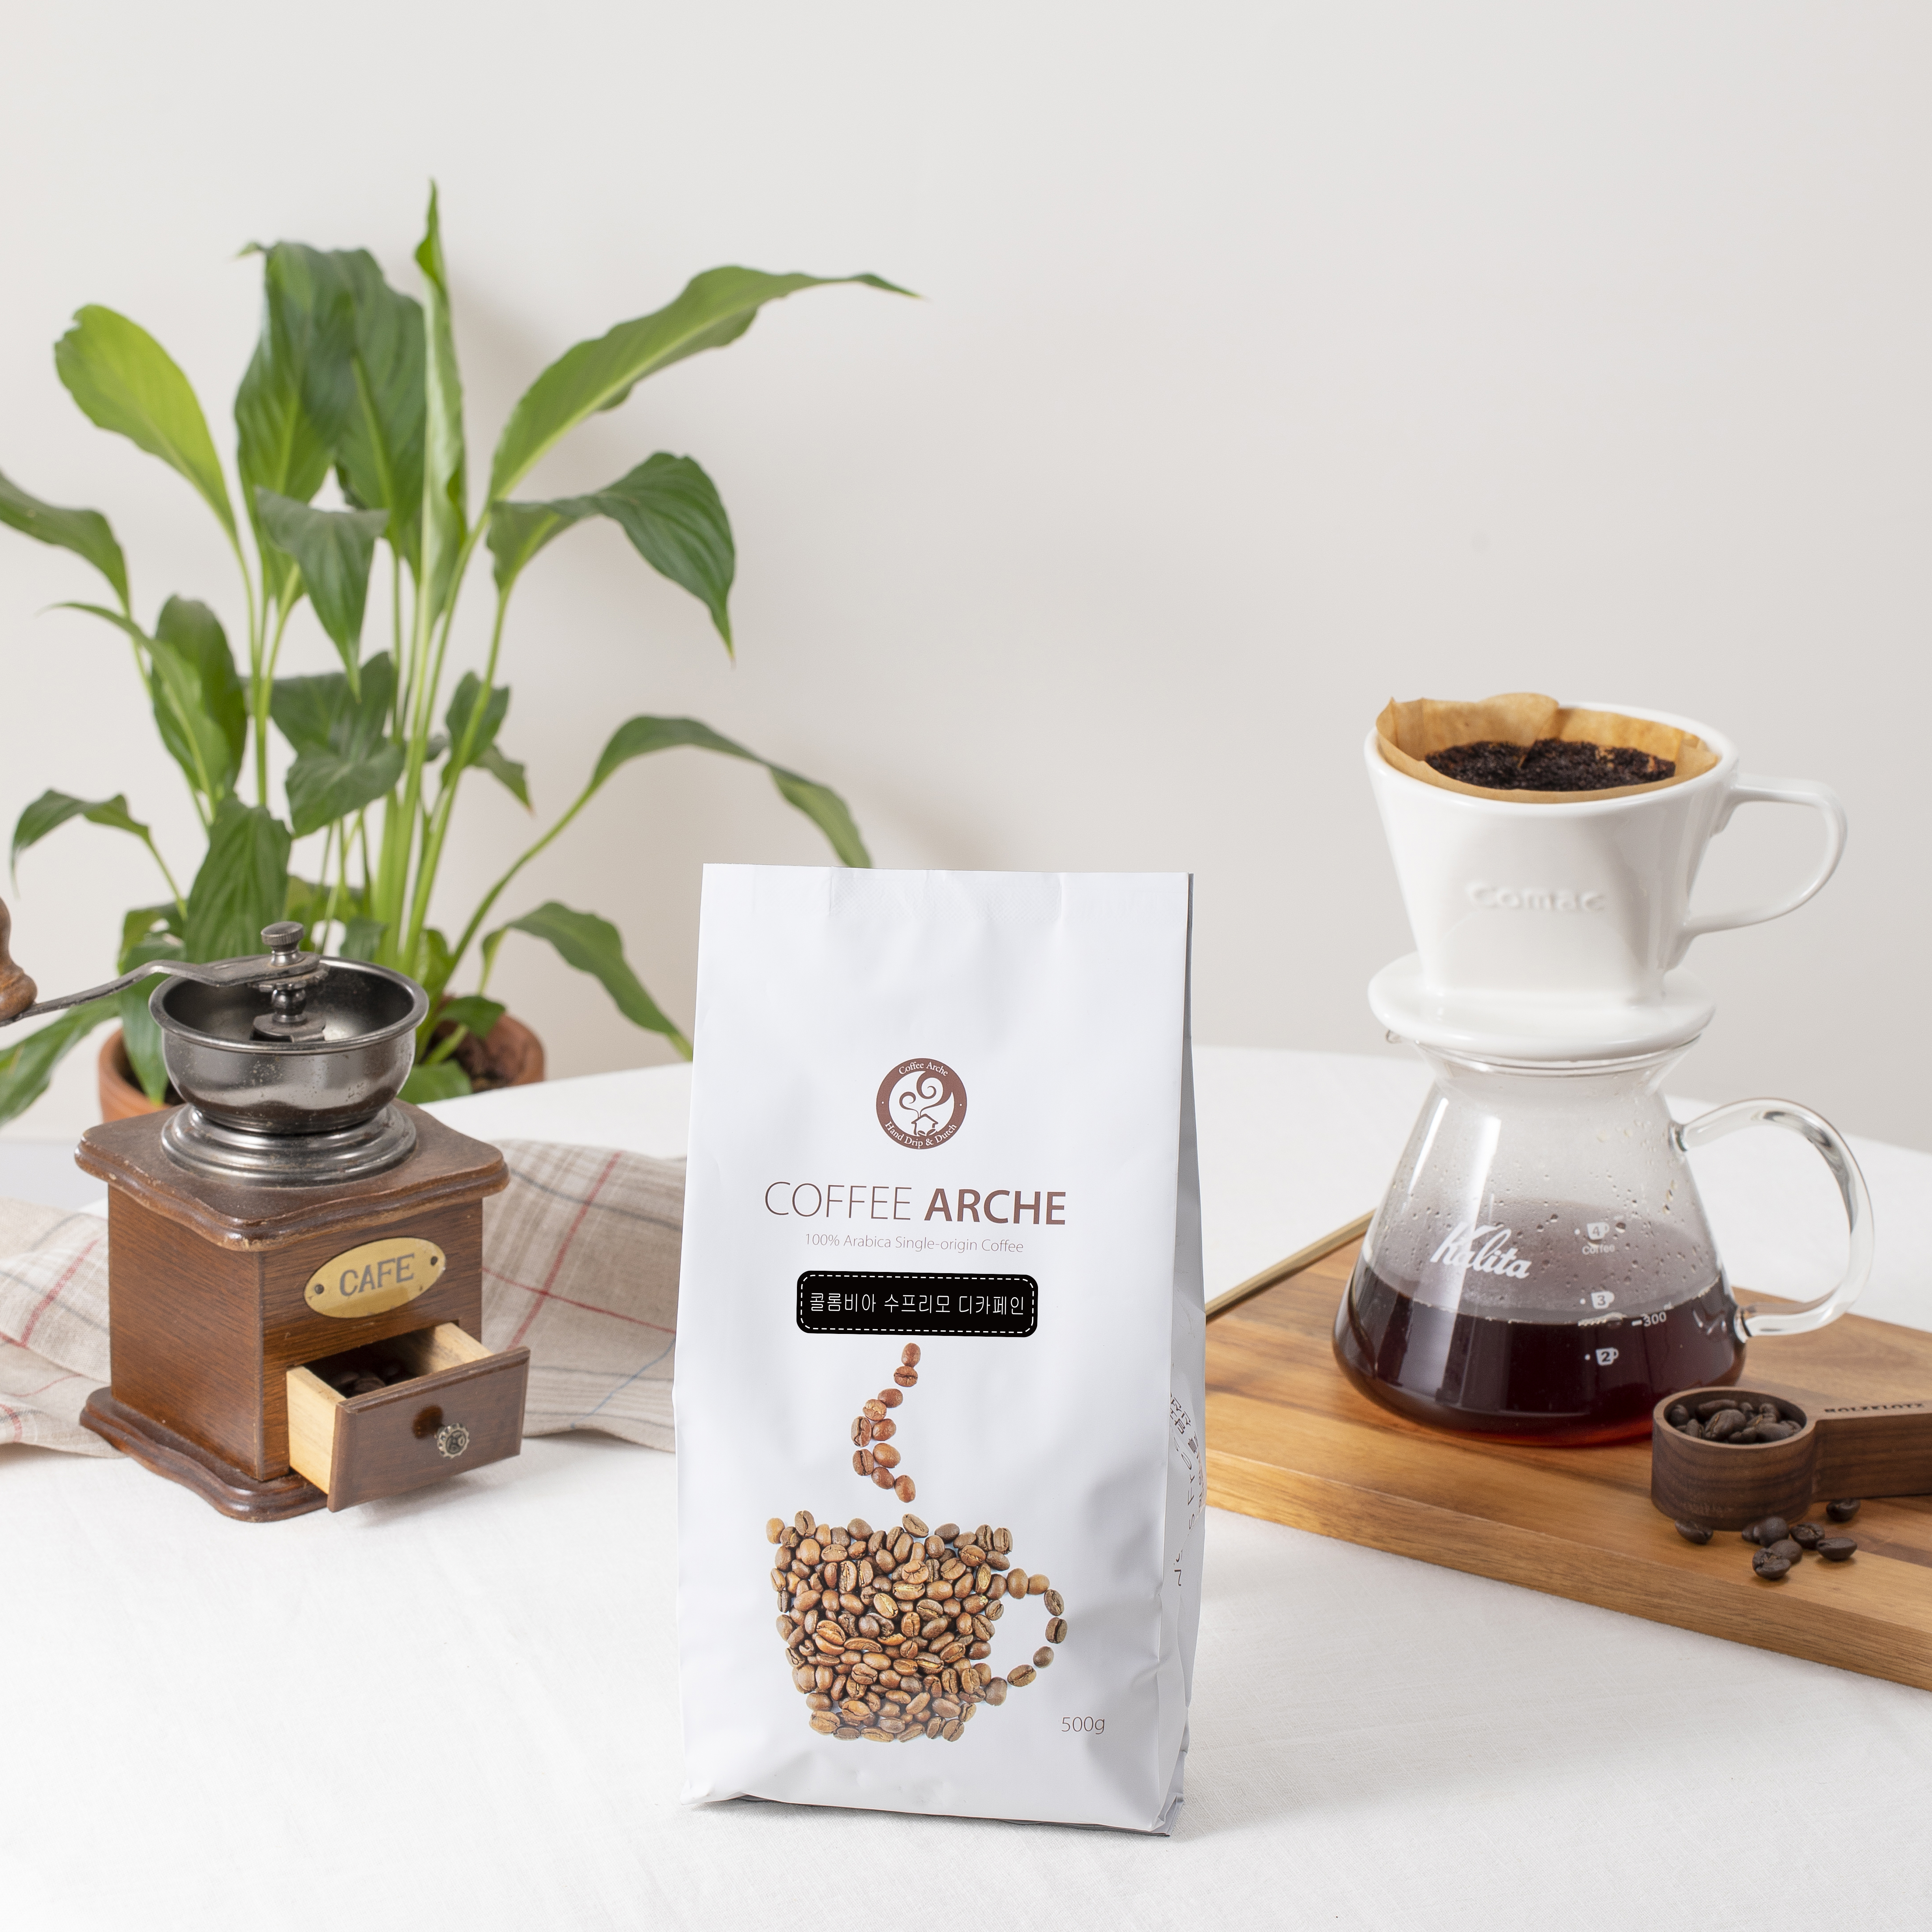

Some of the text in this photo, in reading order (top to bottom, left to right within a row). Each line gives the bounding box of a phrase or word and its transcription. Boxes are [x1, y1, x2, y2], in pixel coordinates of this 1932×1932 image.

[899, 1062, 948, 1076] Coffee Arche
[885, 1121, 905, 1141] Hand
[904, 1136, 923, 1148] Drip
[934, 1124, 957, 1143] Dutch
[765, 1182, 1066, 1225] COFFEE ARCHE
[806, 1233, 1024, 1253] 100% Arabica Single-origin Coffee
[1430, 1224, 1532, 1279] Kalita
[1582, 1244, 1615, 1255] Coffee
[339, 1253, 415, 1296] CAFE
[810, 1293, 1024, 1315] 콜롬비아 수프리모 디카페인
[1601, 1351, 1610, 1362] 2
[1062, 1717, 1104, 1734] 500g
